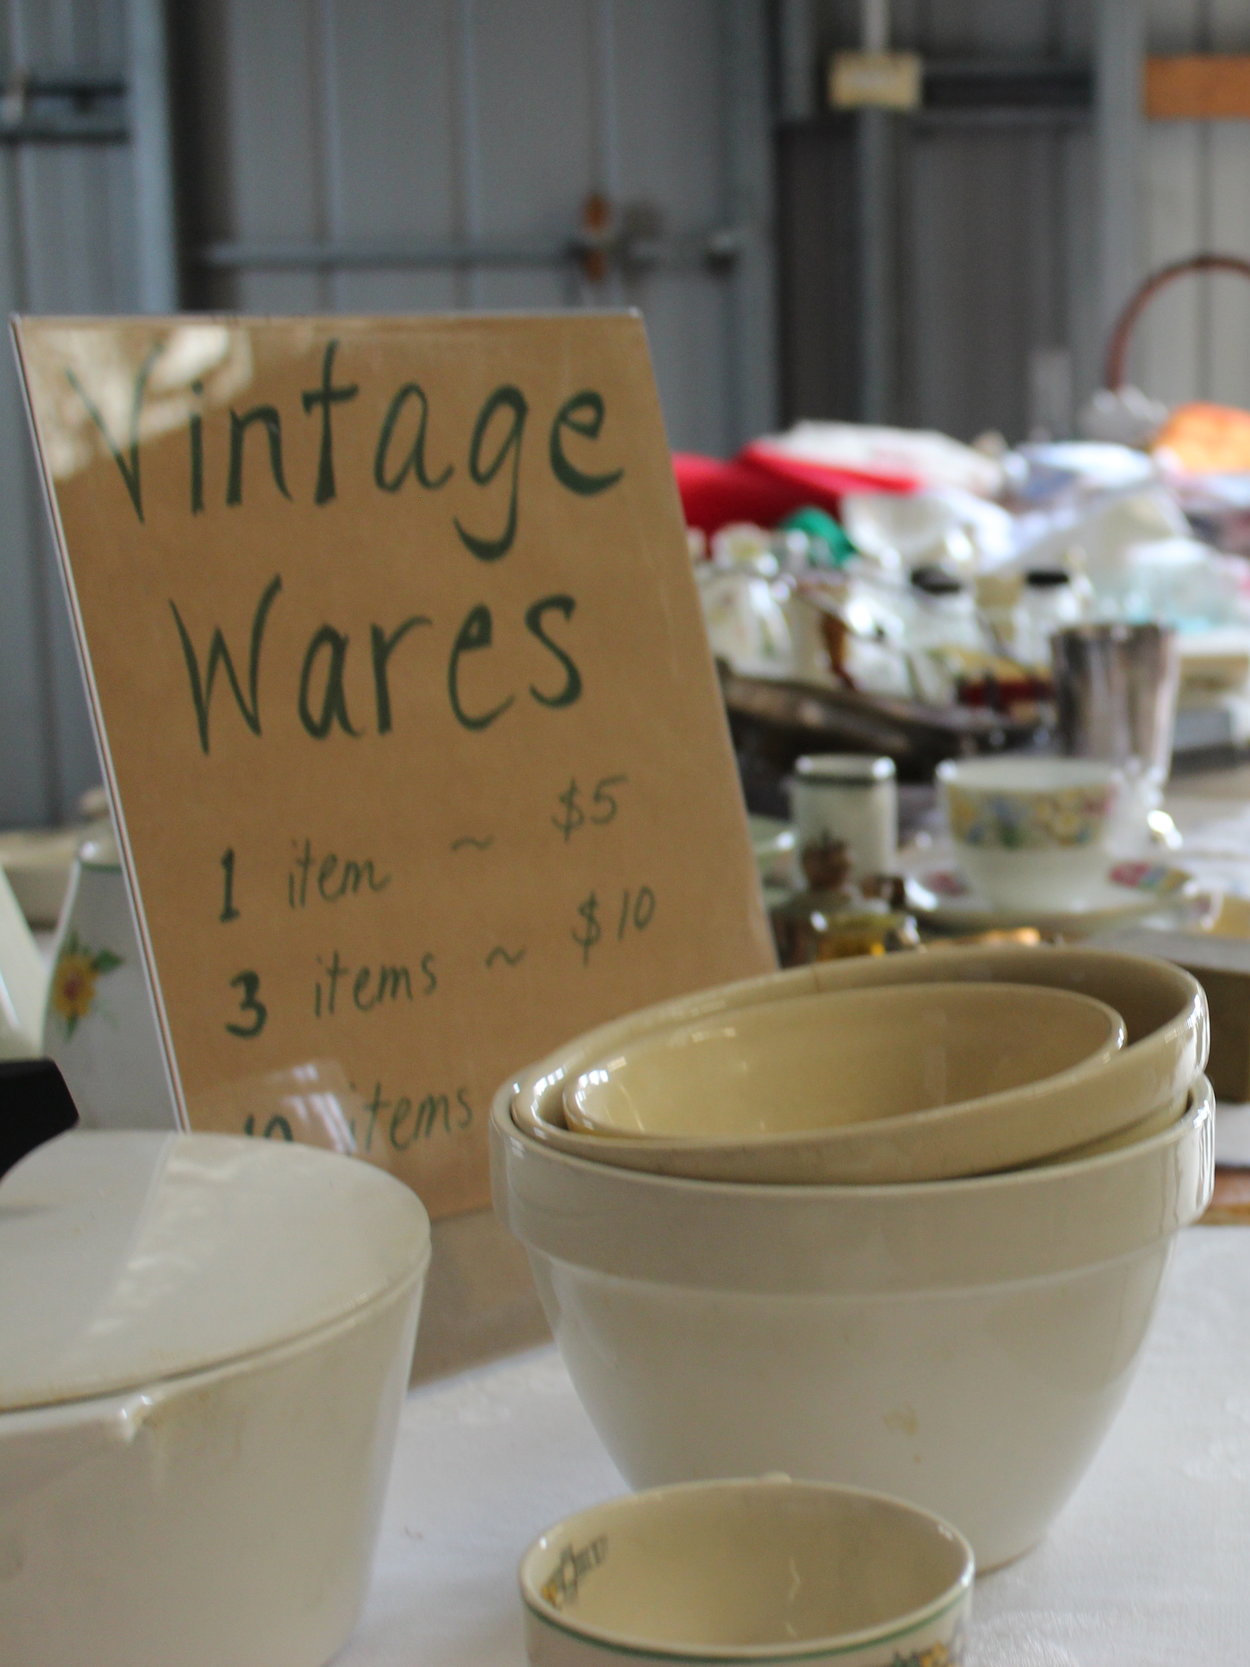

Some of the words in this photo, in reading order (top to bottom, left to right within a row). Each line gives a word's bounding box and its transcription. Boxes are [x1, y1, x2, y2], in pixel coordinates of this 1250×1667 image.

[66, 339, 624, 563] Vintage
[169, 574, 583, 757] Wares
[218, 847, 240, 924] 1
[287, 838, 391, 910] item
[551, 773, 628, 842] $5
[224, 969, 269, 1040] 3
[312, 949, 438, 1019] items
[571, 885, 657, 966] $10
[350, 1080, 474, 1153] items
